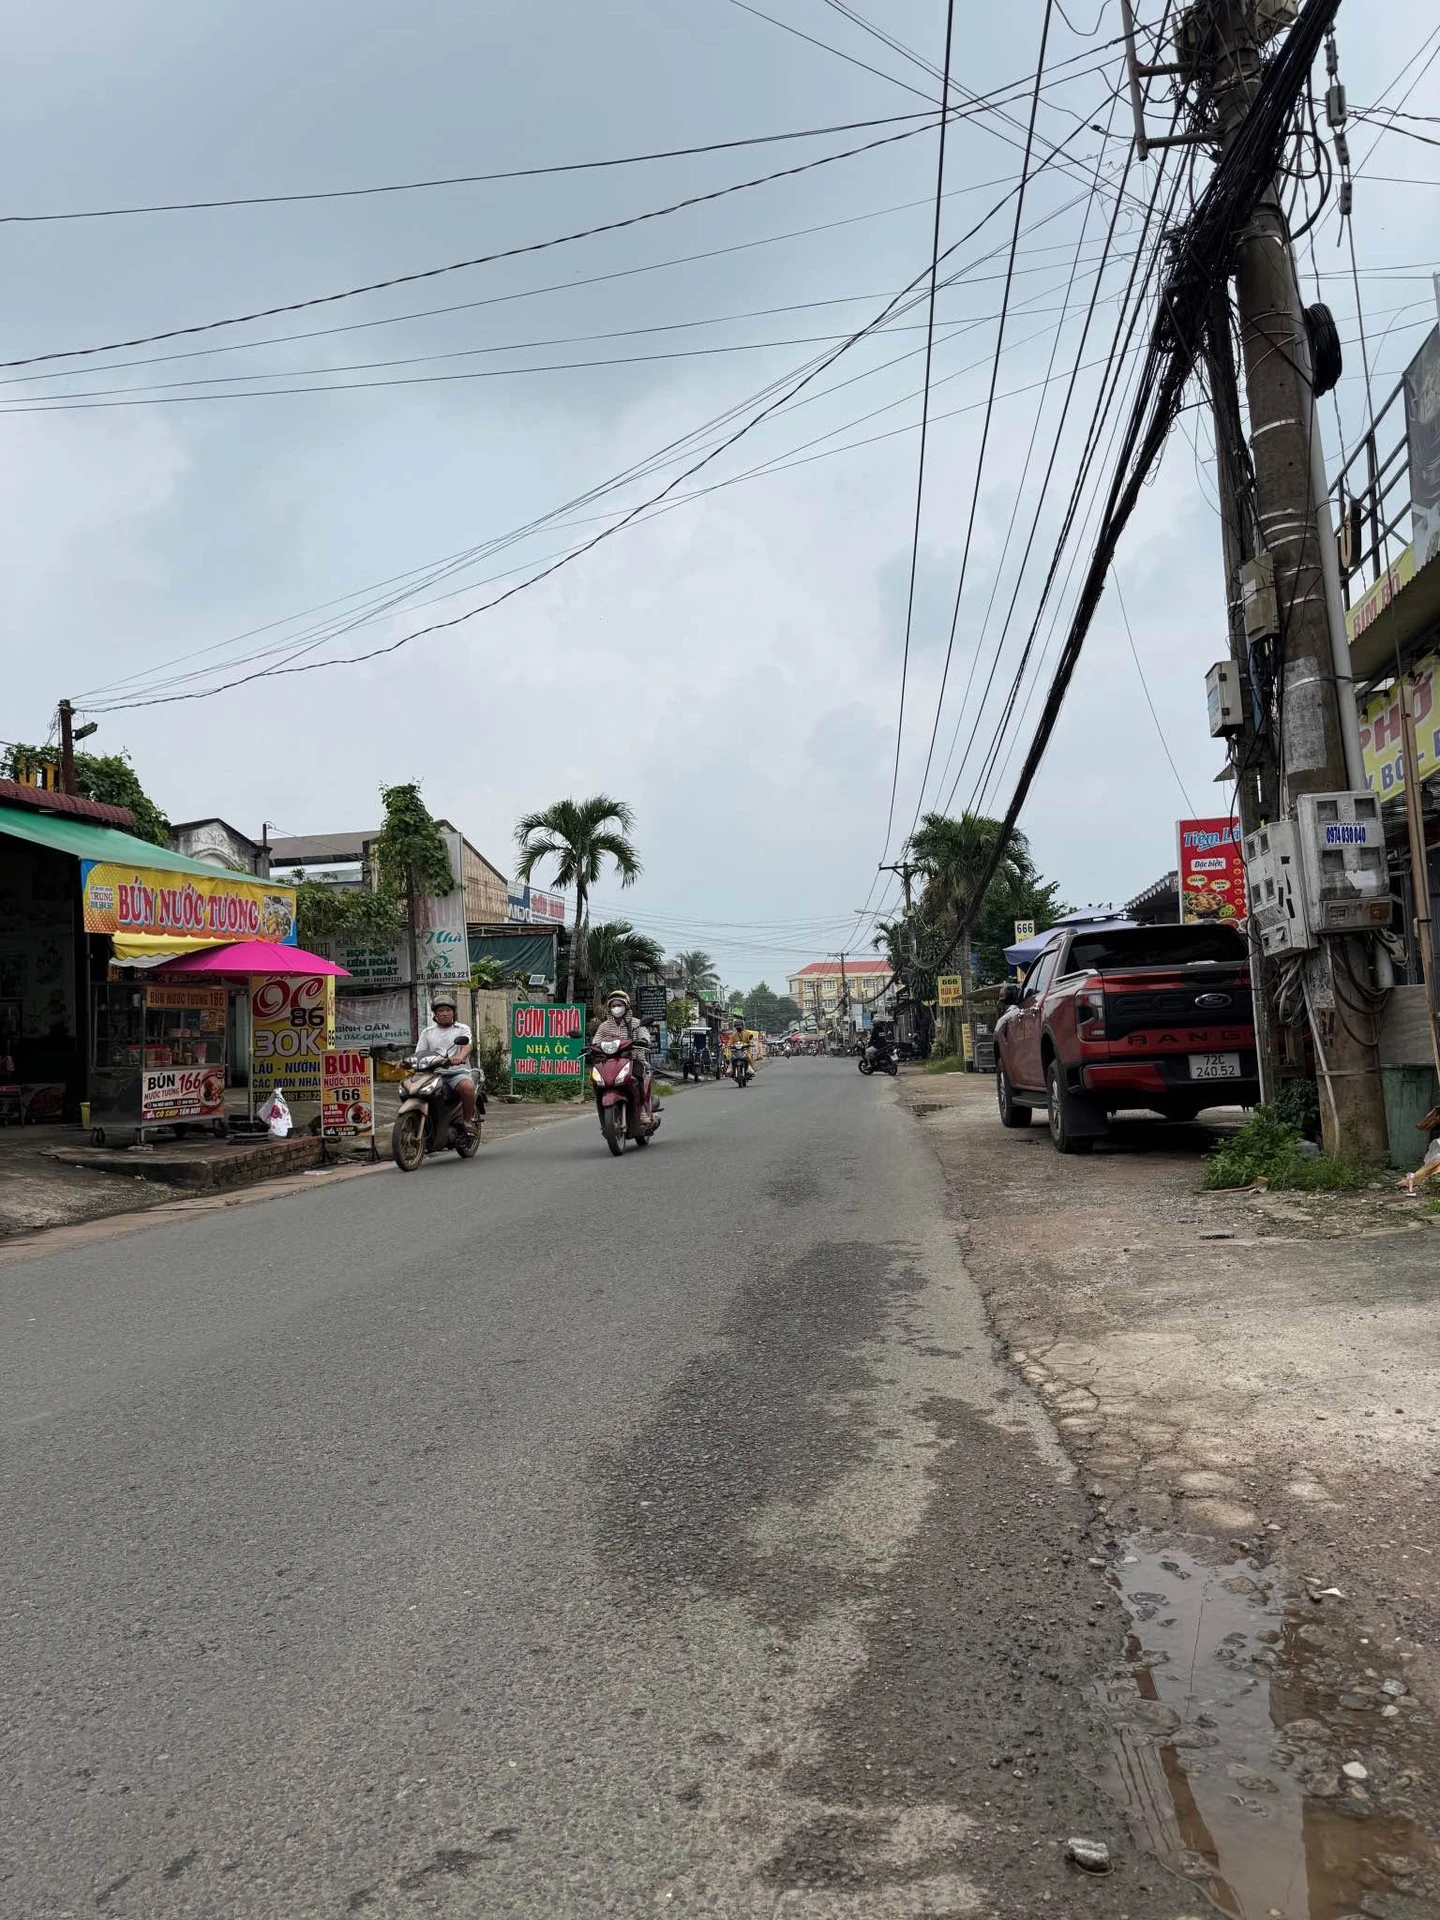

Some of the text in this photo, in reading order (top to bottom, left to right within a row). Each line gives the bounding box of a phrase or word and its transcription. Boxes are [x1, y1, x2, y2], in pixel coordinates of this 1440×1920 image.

[118, 875, 156, 925] BÚN
[159, 882, 205, 931] NƯỚC
[1017, 922, 1033, 934] 666
[425, 929, 464, 945] Nhà
[210, 990, 224, 1007] 166
[290, 1006, 325, 1028] 86
[515, 1005, 582, 1038] CƠM TRƯA
[254, 1028, 321, 1058] 30K
[526, 1040, 570, 1055] NHÀ ỐC
[252, 1058, 273, 1074] LẨU
[325, 1049, 365, 1075] BÚN
[514, 1056, 581, 1075] THỨC ĂN NÓNG
[1203, 1054, 1226, 1065] 72C
[1196, 1065, 1235, 1078] 240.52
[147, 1072, 201, 1094] BÚN 166
[324, 1075, 344, 1087] NƯỚC
[334, 1088, 360, 1101] 166
